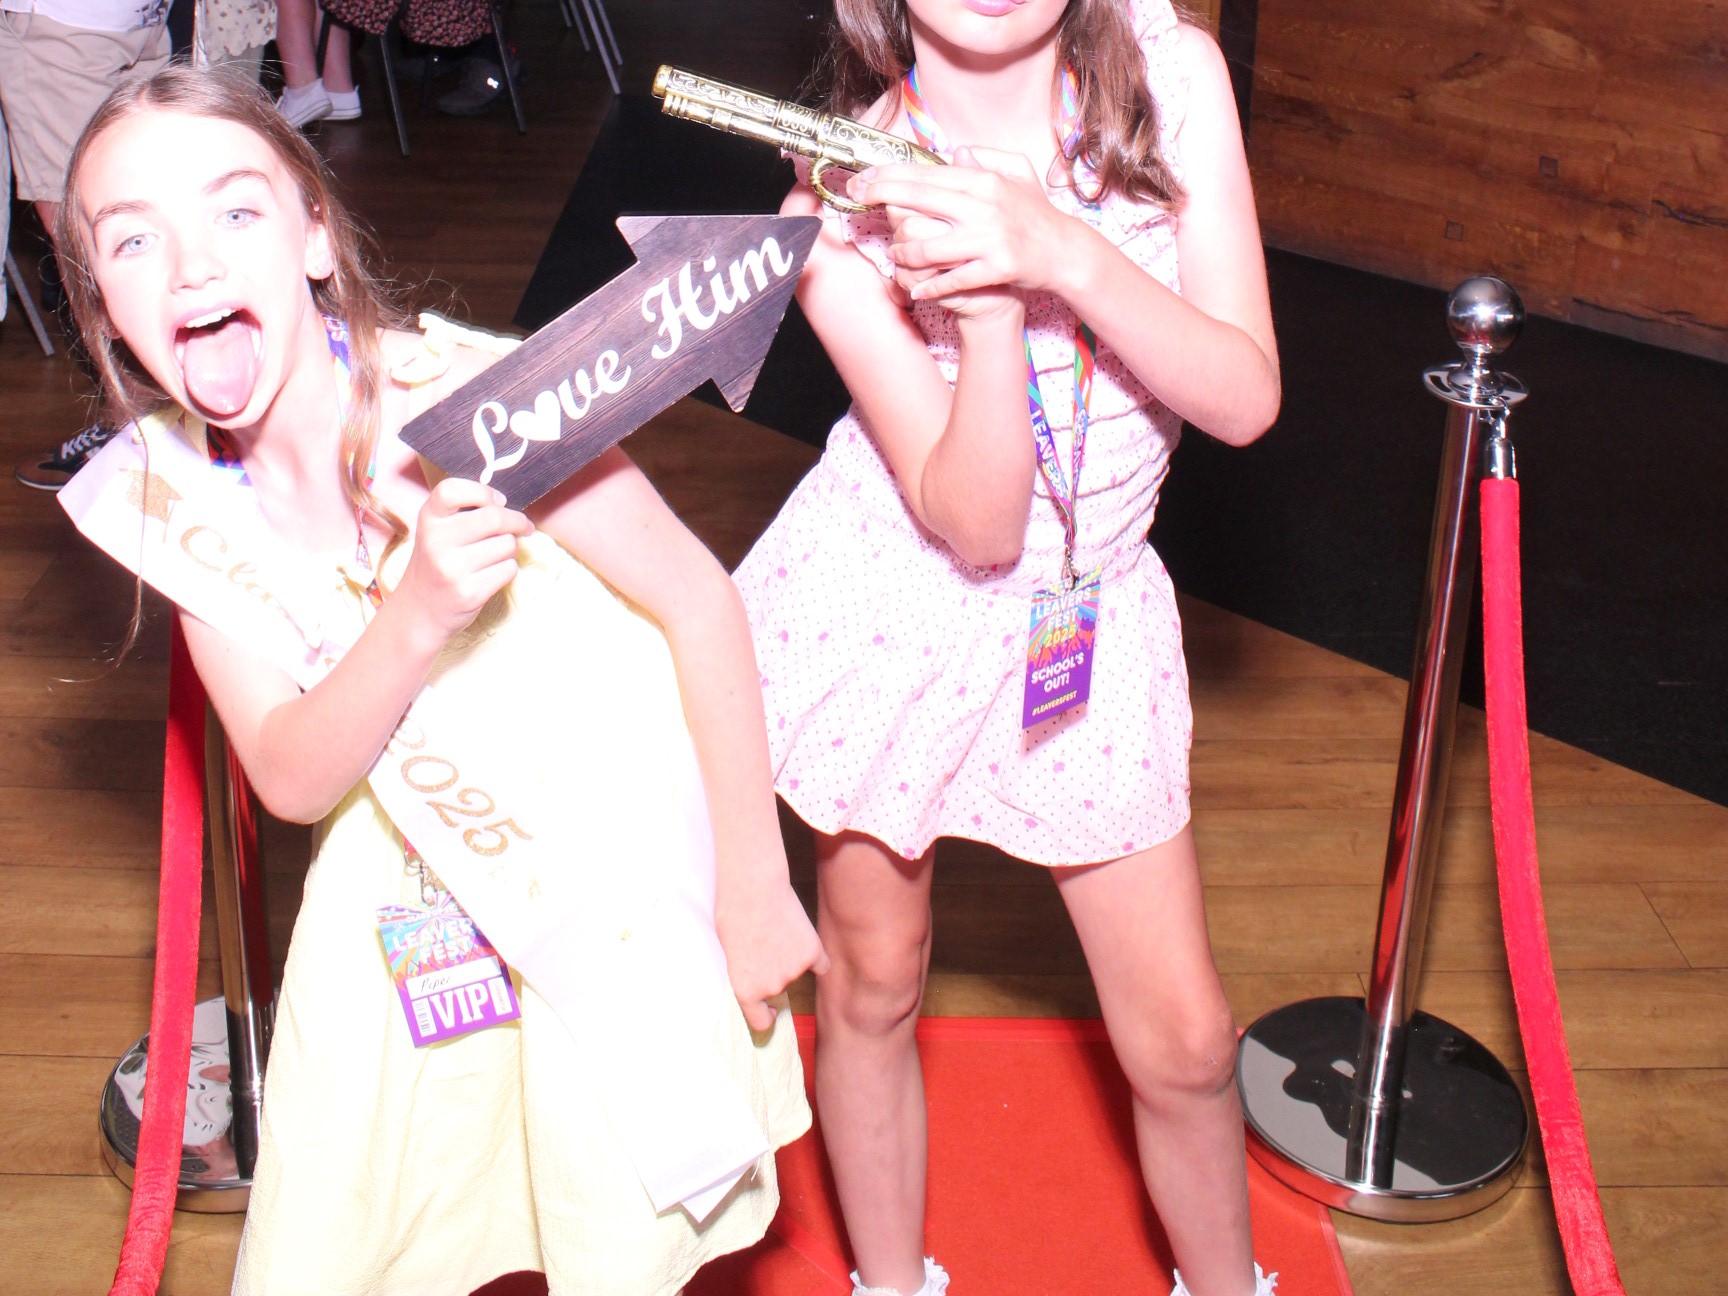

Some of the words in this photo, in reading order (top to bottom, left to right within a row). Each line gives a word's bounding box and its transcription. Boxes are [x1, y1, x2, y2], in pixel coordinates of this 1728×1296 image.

[641, 236, 794, 360] Him
[1035, 587, 1092, 621] LEAVERS
[1047, 606, 1079, 631] FEST
[1045, 626, 1077, 648] 2025
[1030, 652, 1085, 685] SCHOOL'S
[1043, 672, 1070, 693] OUT!
[1031, 690, 1078, 716] #LEAVERSFEST
[392, 919, 475, 953] LEAVER
[419, 936, 471, 965] FEST
[429, 982, 489, 1030] VIP
